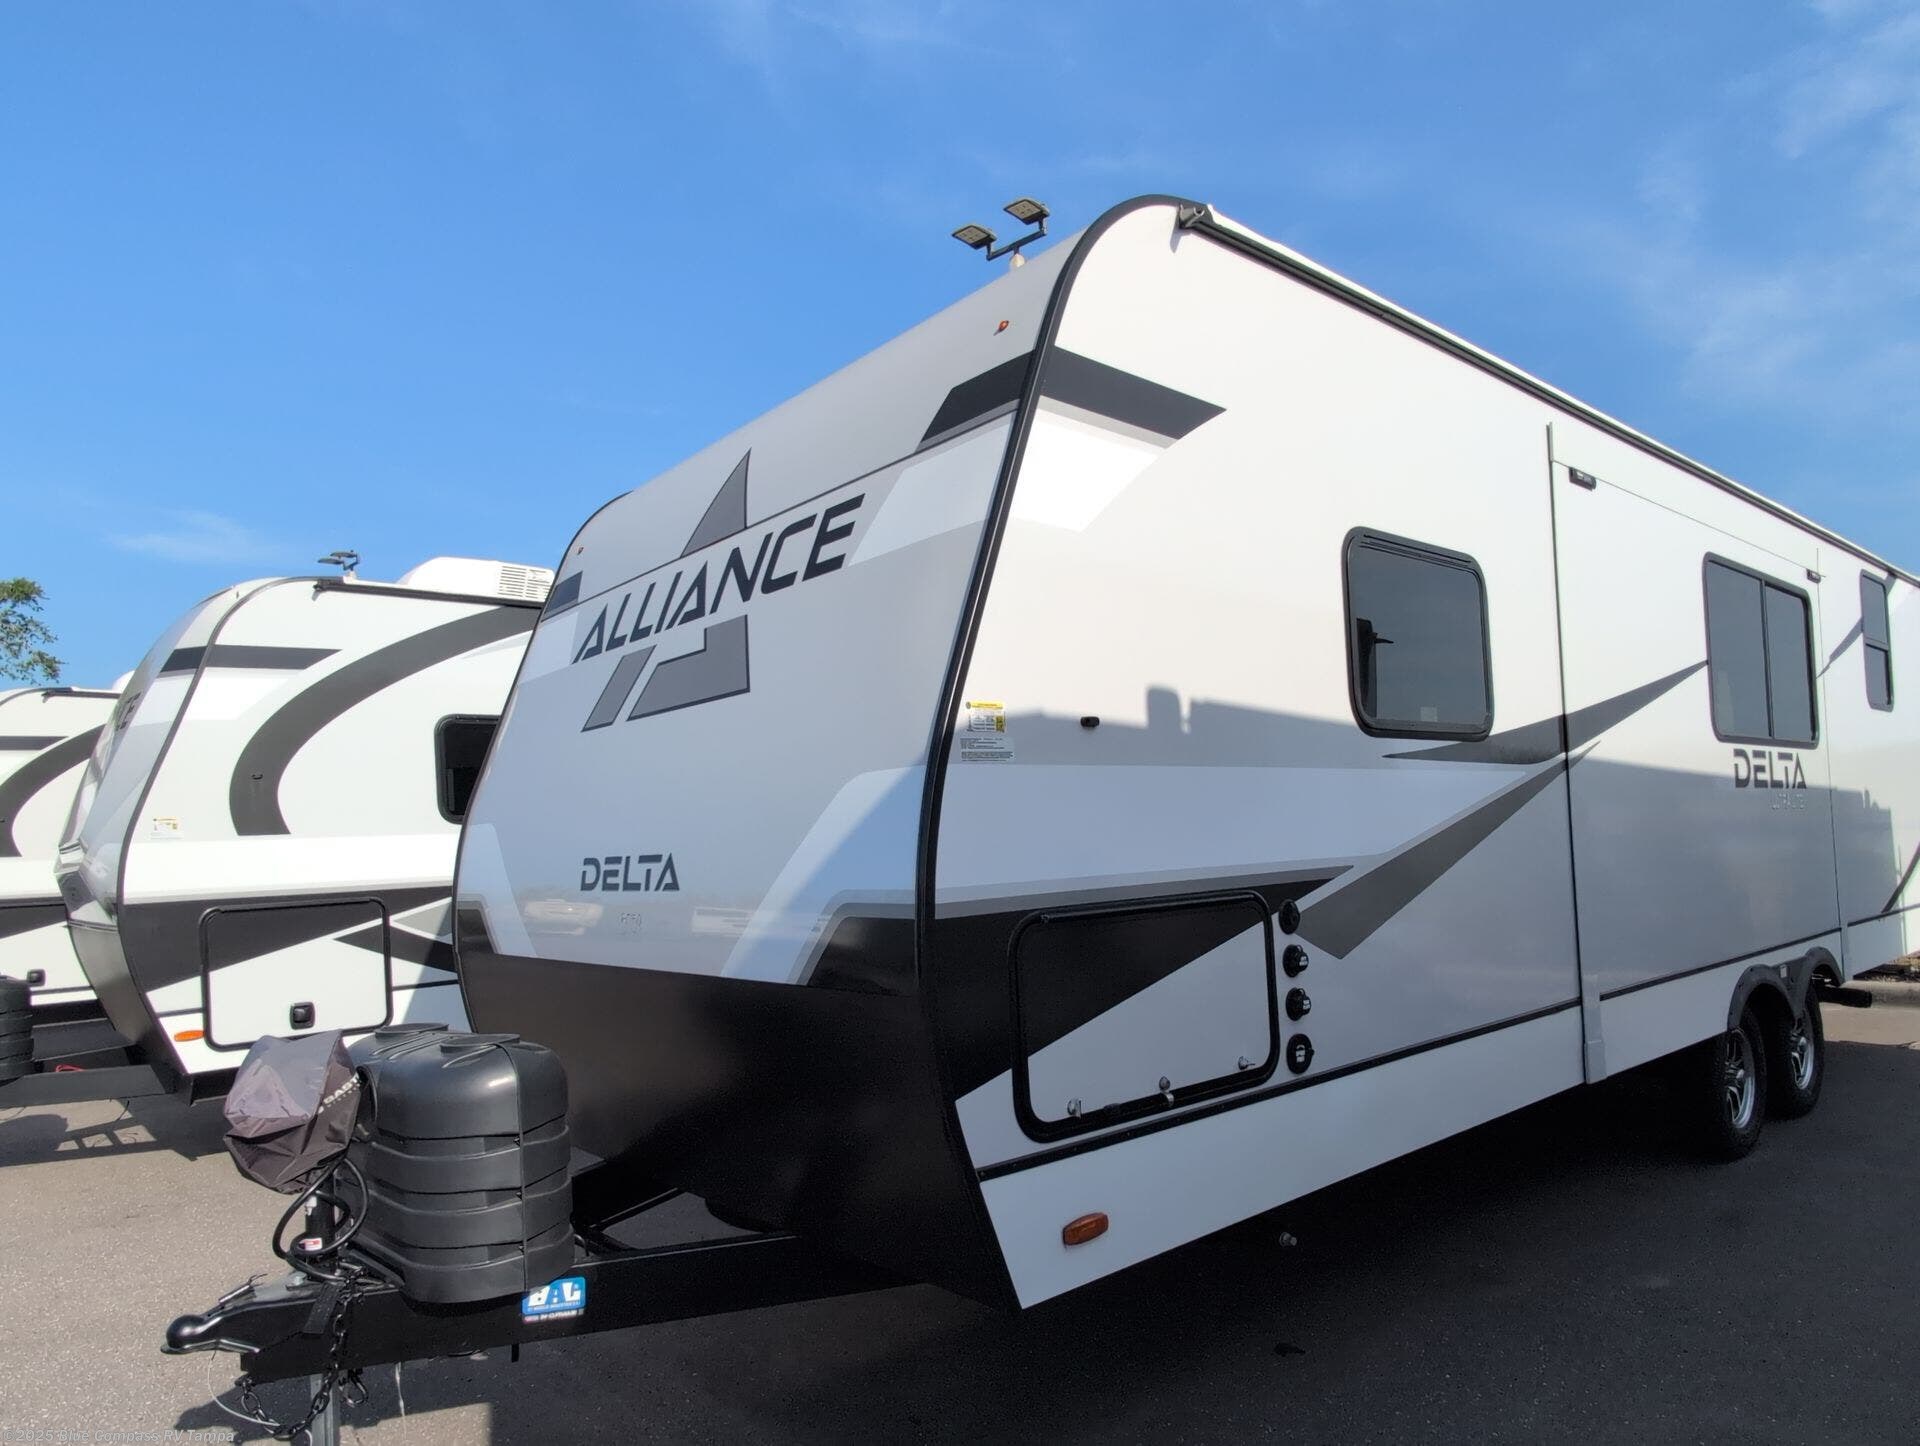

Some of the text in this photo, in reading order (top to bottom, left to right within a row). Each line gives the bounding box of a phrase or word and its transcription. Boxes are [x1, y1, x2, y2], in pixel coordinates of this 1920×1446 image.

[572, 493, 866, 665] ALLIANCE
[1734, 748, 1807, 789] DELTA
[580, 852, 681, 892] DELTA
